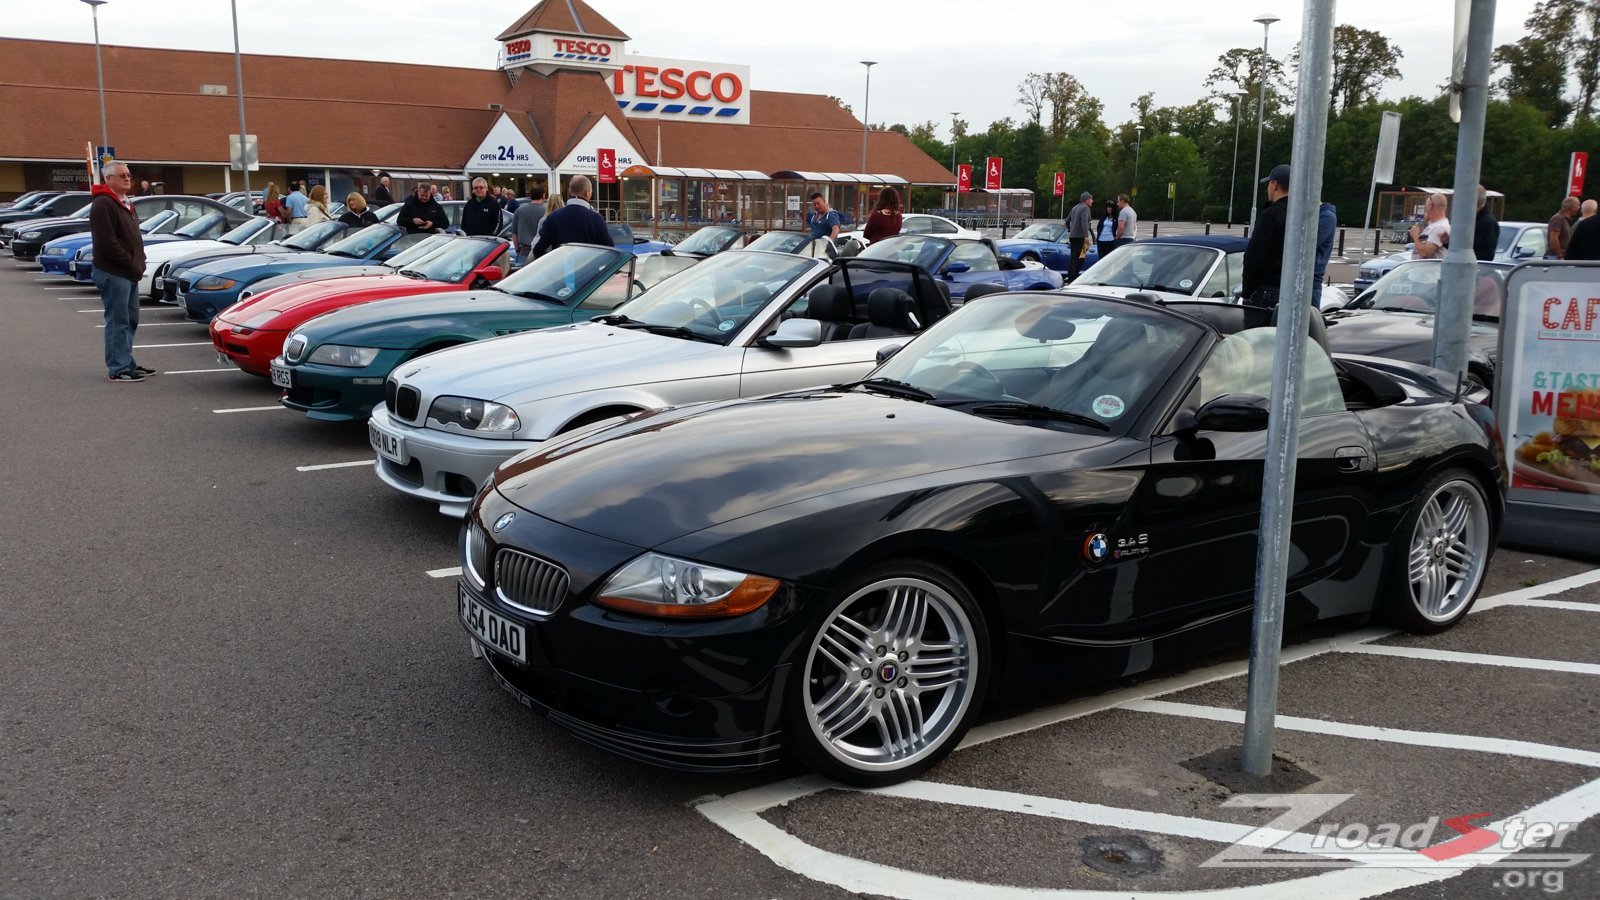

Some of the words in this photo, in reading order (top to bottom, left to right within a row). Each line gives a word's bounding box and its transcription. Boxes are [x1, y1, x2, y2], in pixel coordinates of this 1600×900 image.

[506, 39, 531, 55] TESCO
[553, 39, 611, 56] TESCO
[613, 64, 743, 103] TESCO
[498, 145, 515, 161] 24
[1531, 391, 1600, 419] MEN
[381, 433, 398, 457] NLR
[461, 590, 486, 637] FJ54
